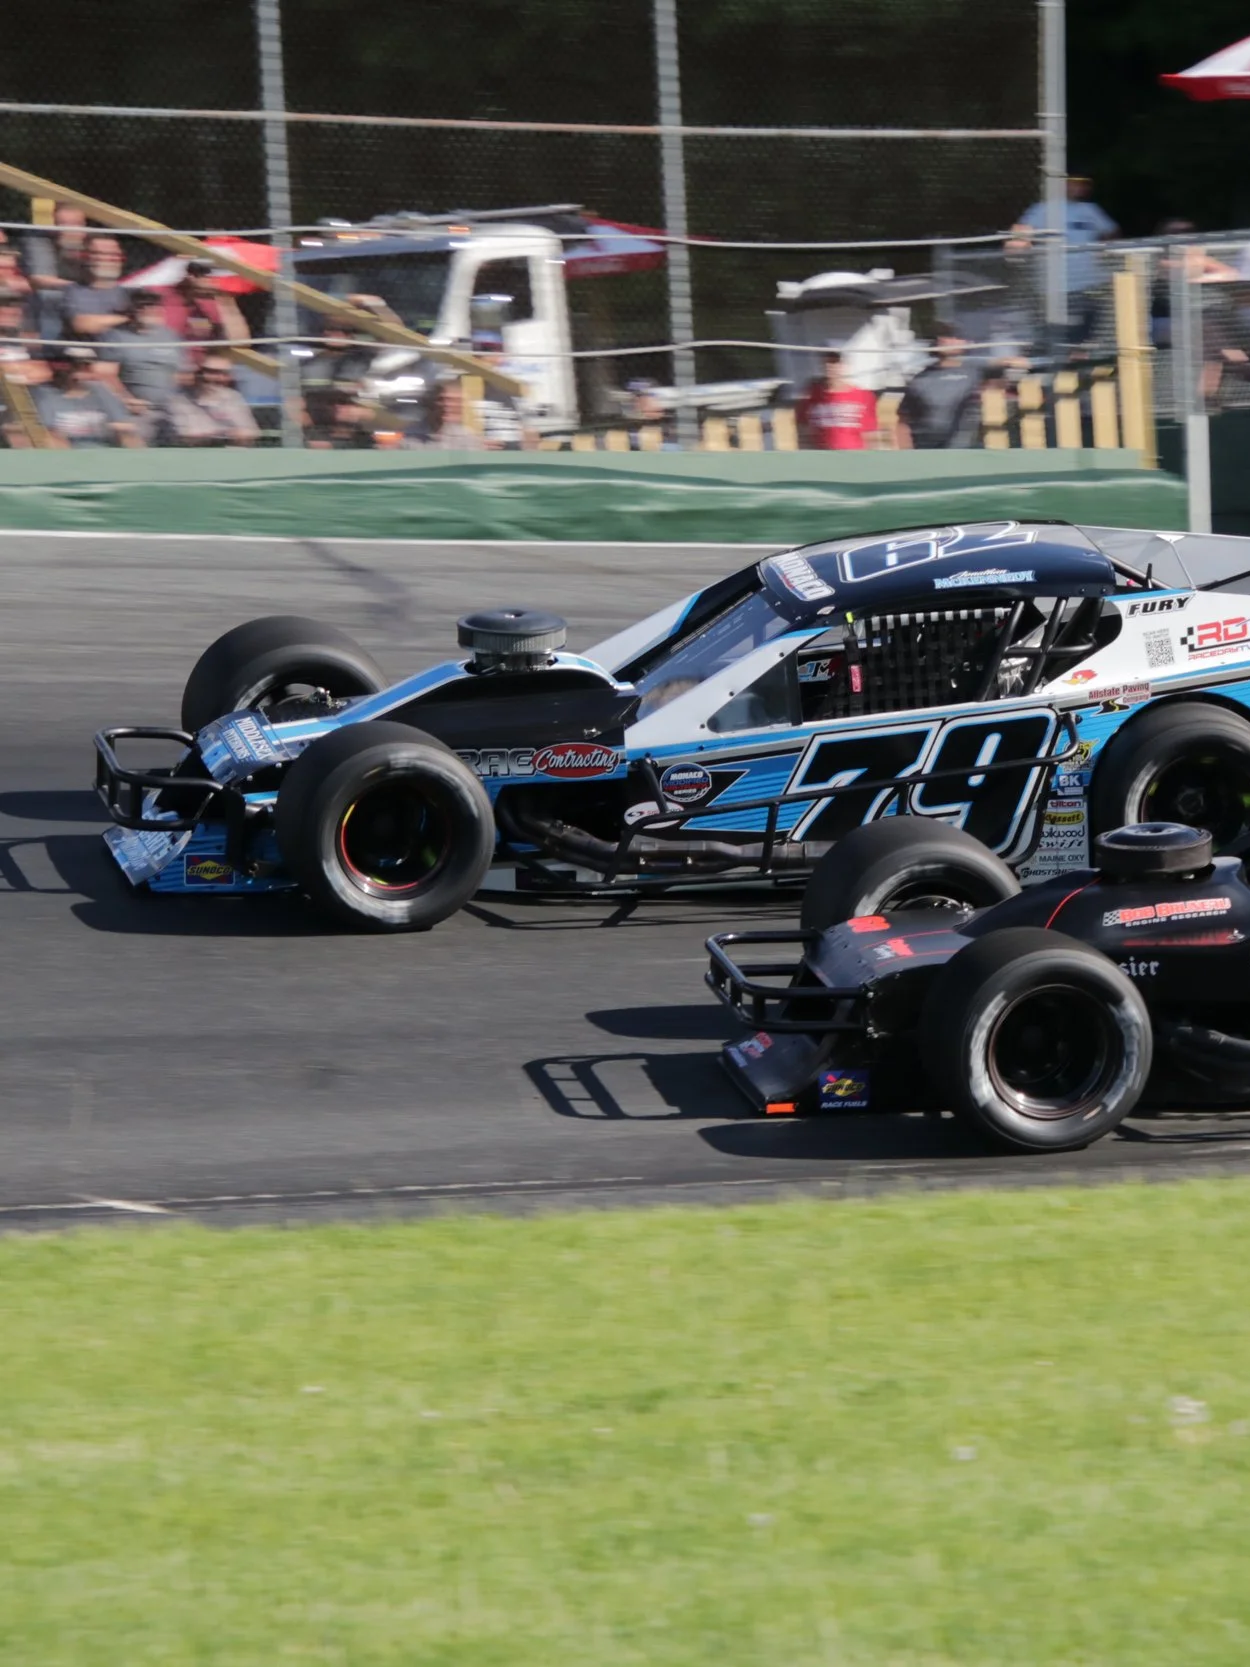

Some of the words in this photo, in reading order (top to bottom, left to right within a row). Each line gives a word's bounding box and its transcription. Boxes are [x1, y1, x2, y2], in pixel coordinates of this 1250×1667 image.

[1129, 596, 1190, 615] FURY
[1089, 686, 1121, 700] Allstate
[1122, 682, 1150, 694] Paving
[535, 748, 621, 773] Contracting
[784, 705, 1058, 856] 79
[1059, 775, 1081, 786] BK
[1039, 855, 1066, 863] MAINE
[1068, 854, 1085, 862] OXY
[187, 865, 233, 875] SUNOCO
[1119, 905, 1155, 922] BOB
[1118, 956, 1160, 976] sier
